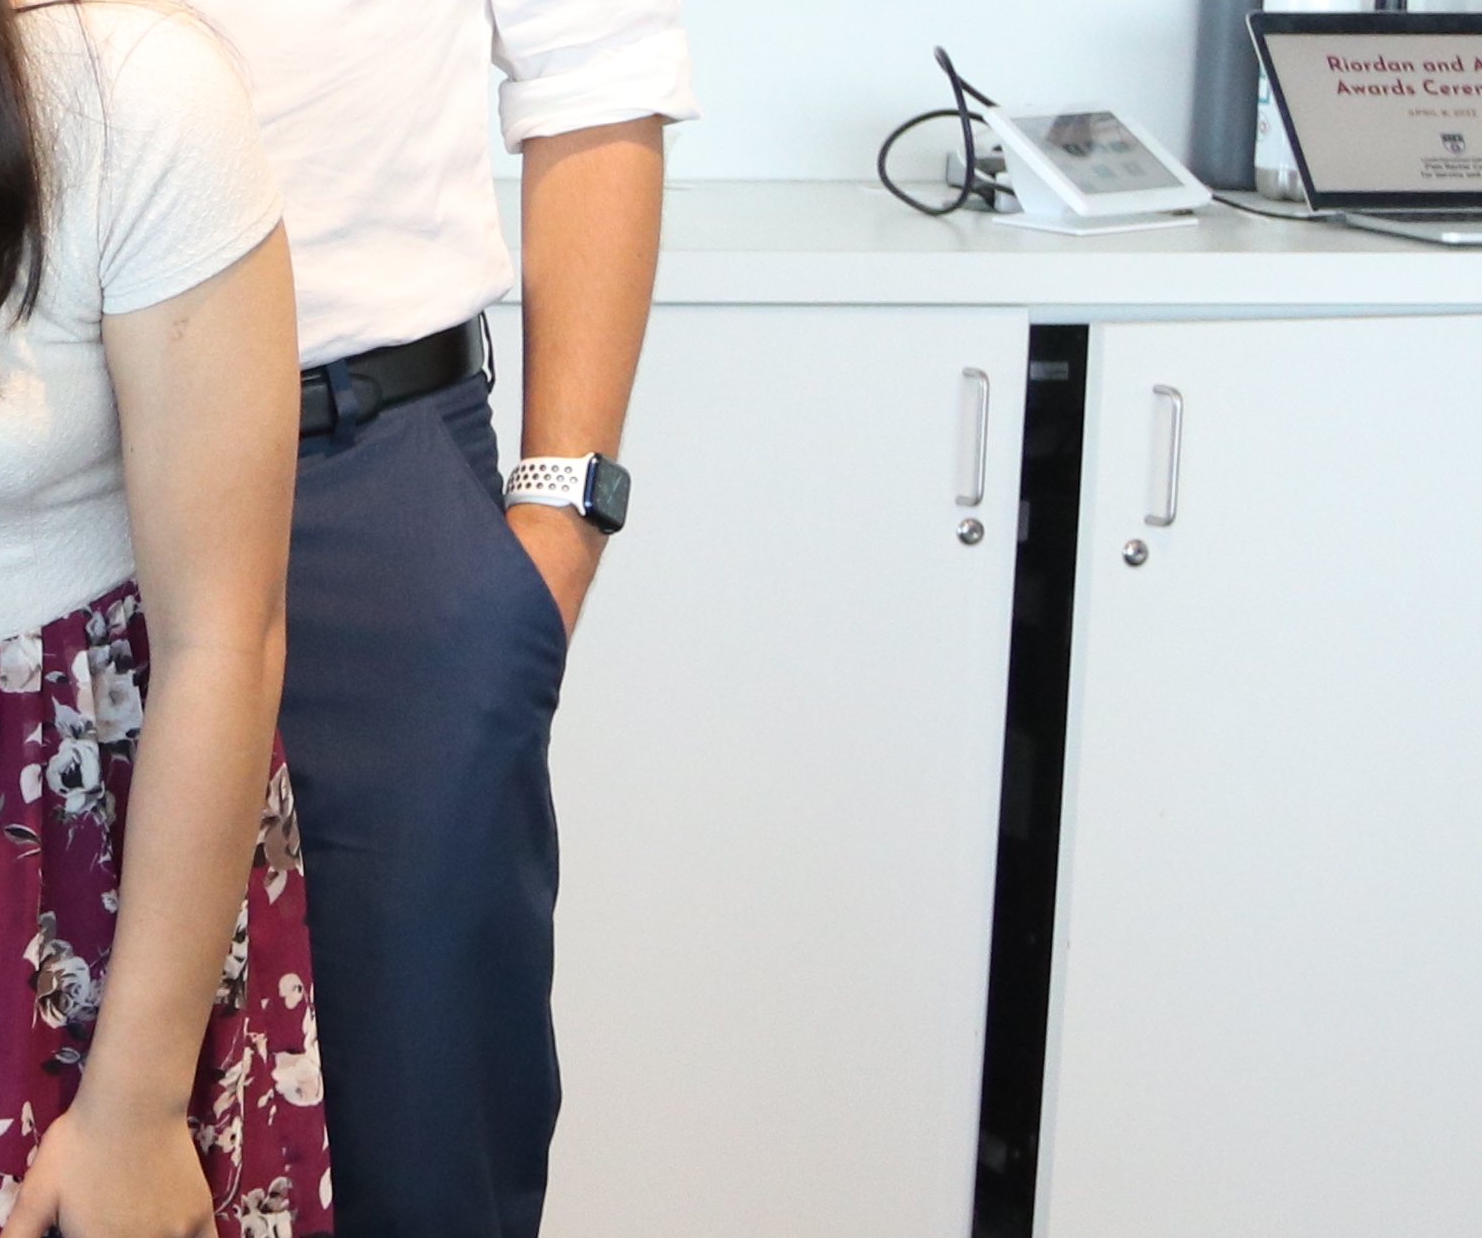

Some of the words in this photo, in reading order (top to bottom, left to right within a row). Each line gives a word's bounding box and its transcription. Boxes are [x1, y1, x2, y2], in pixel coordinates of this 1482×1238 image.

[1327, 55, 1415, 73] Riordan
[1423, 54, 1465, 73] and
[1337, 78, 1416, 96] Awards
